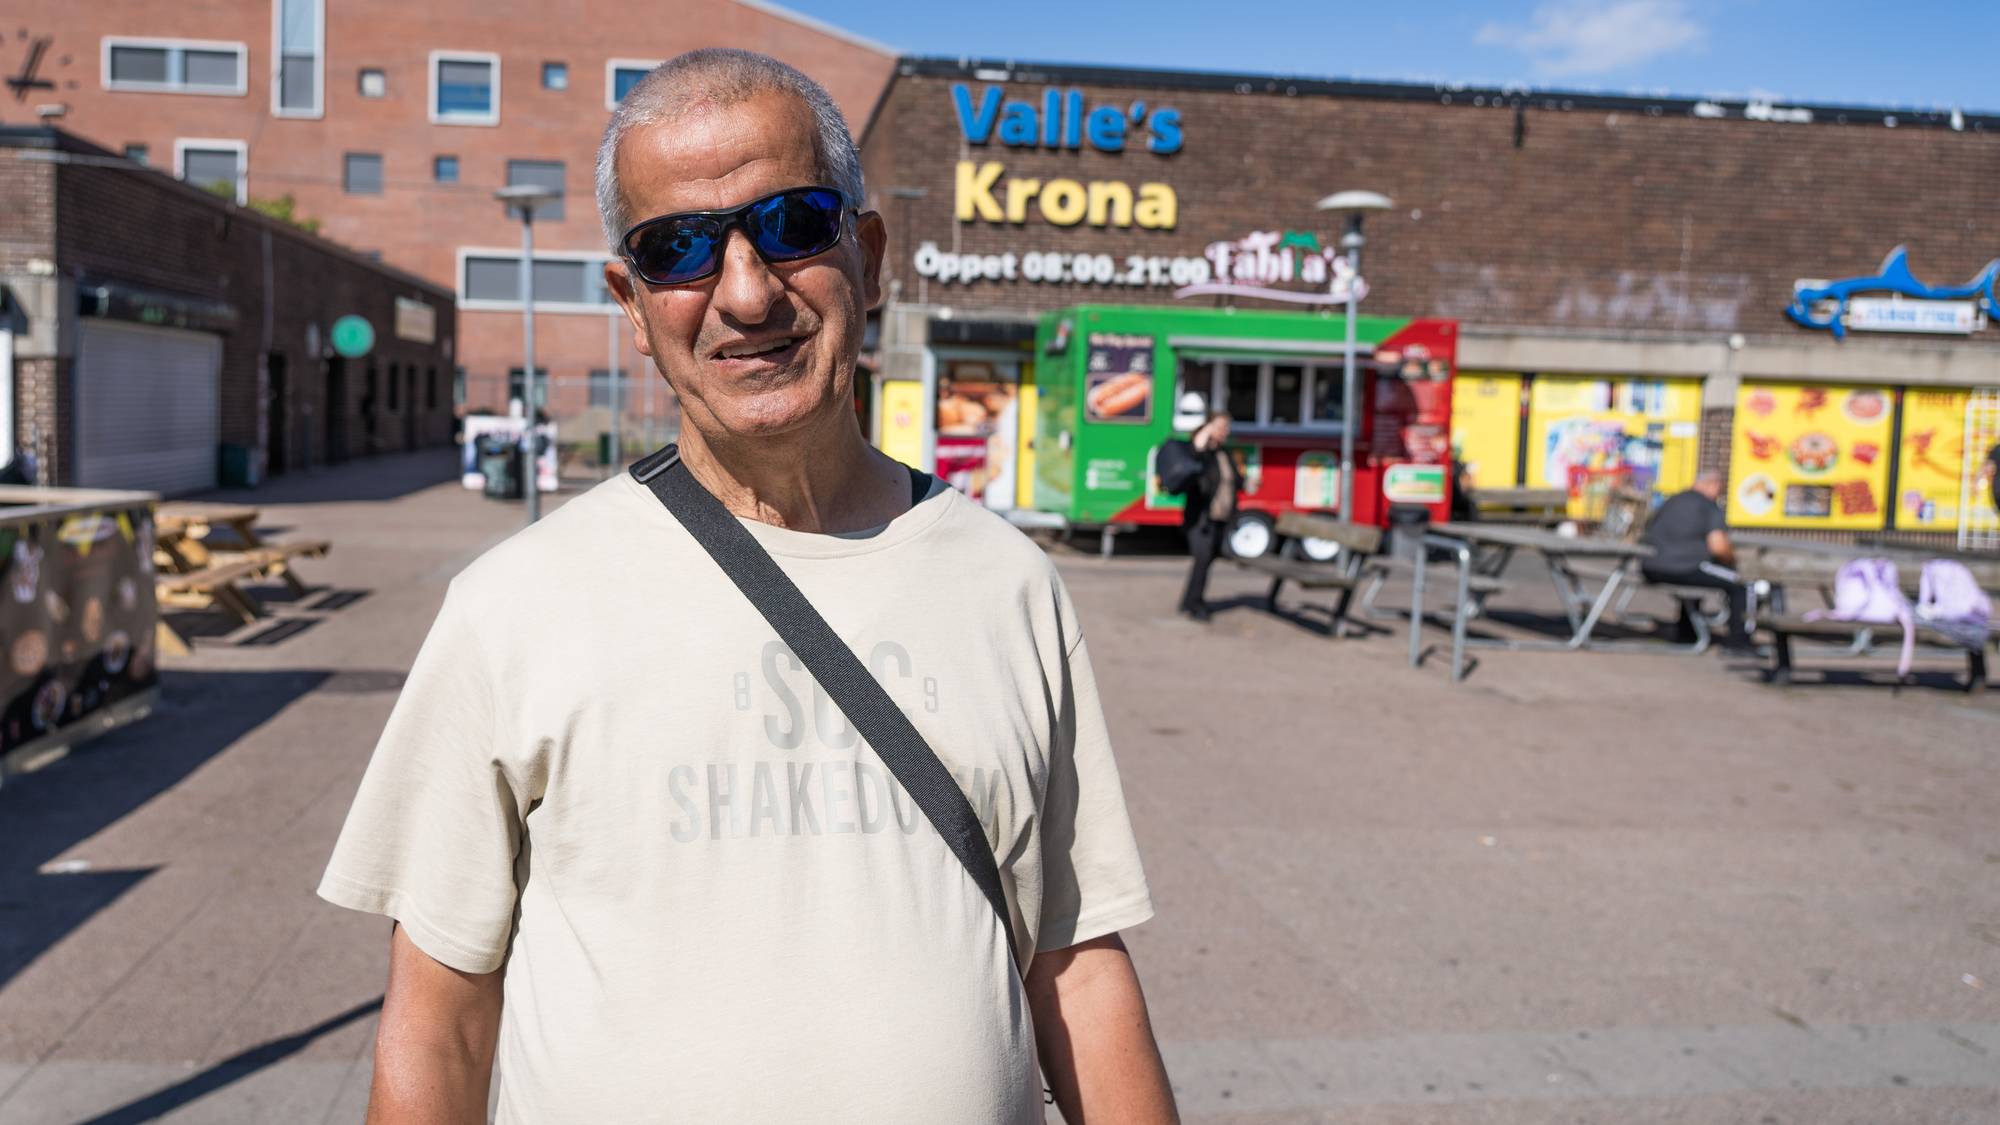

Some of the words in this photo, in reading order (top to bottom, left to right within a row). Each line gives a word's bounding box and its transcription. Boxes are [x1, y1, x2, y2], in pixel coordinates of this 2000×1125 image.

[952, 84, 1184, 152] Valle's
[955, 161, 1178, 229] Krona
[914, 241, 1017, 283] Öppet
[733, 671, 752, 712] 8
[923, 676, 939, 714] 9
[668, 760, 1001, 843] SHAKEDON
